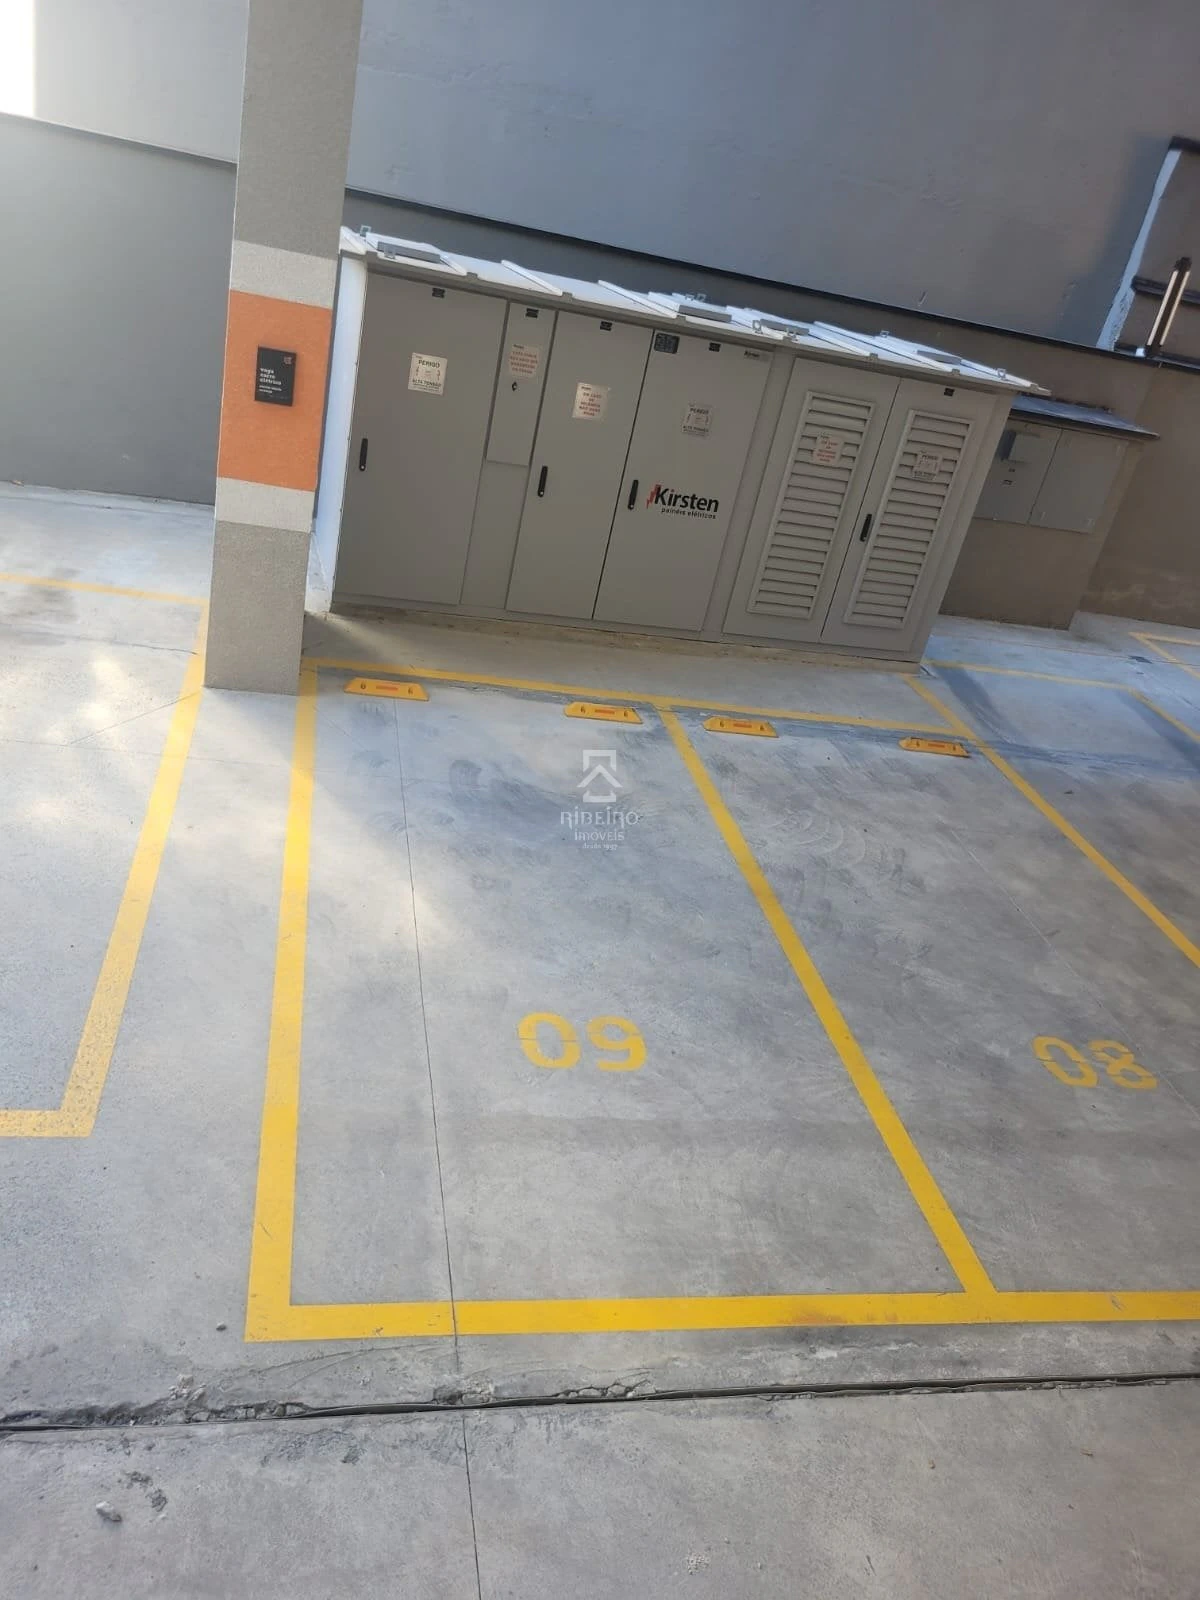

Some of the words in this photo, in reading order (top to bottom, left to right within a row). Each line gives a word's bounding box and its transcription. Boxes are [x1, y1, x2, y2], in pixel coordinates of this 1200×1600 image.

[654, 484, 719, 512] Kirsten
[517, 1010, 648, 1072] 09
[1032, 1034, 1158, 1090] 08
